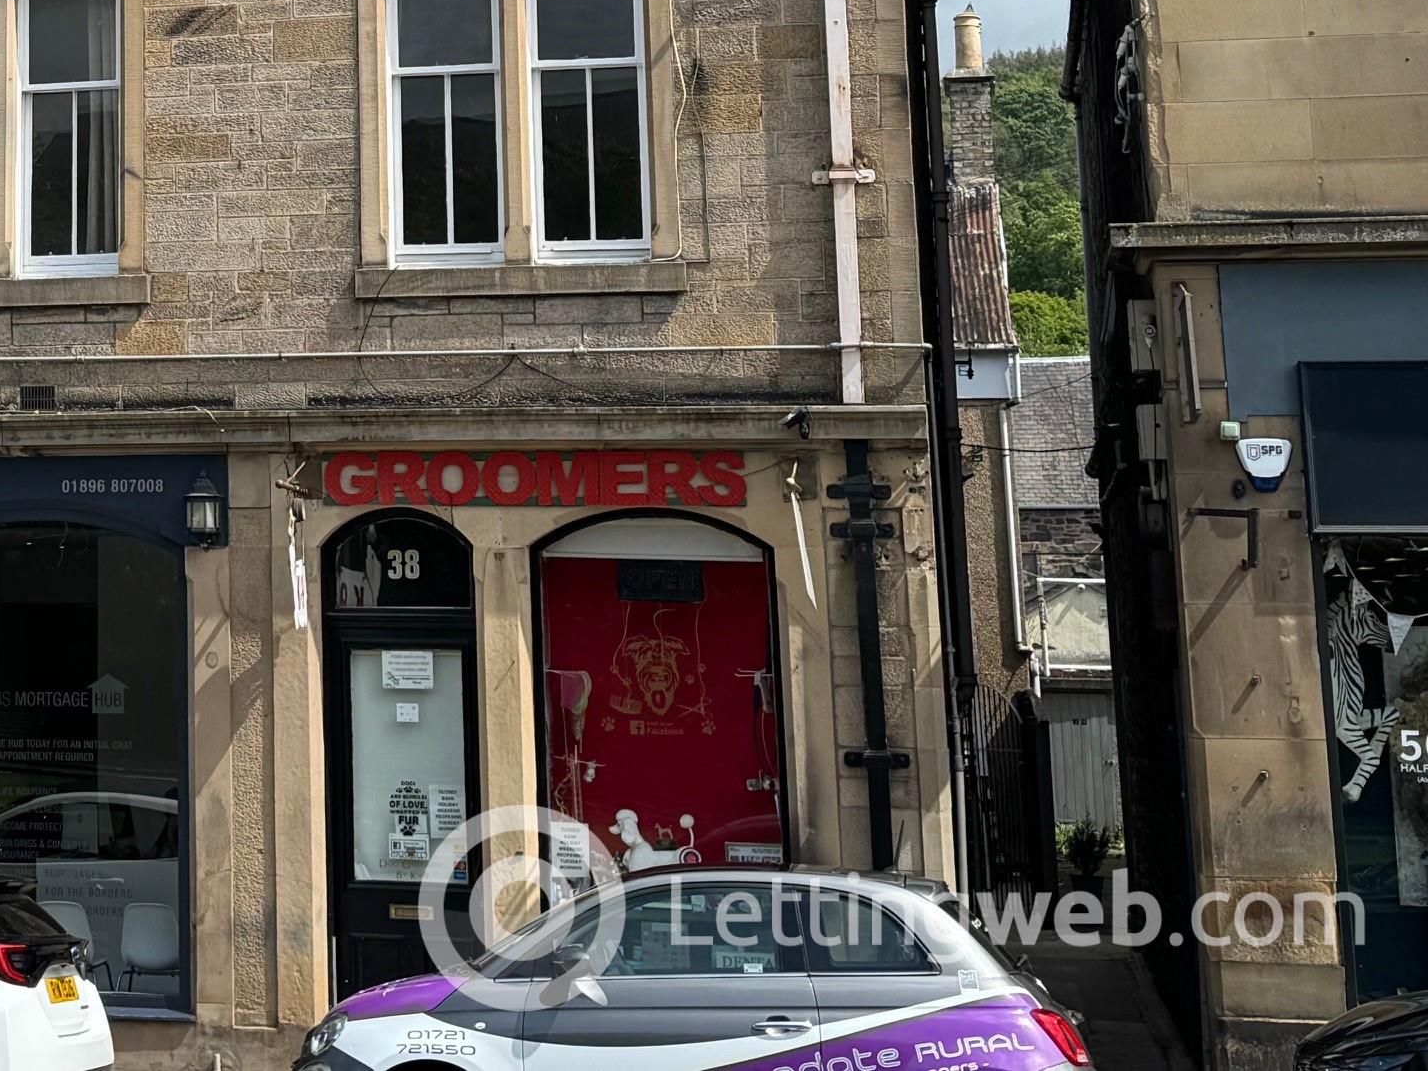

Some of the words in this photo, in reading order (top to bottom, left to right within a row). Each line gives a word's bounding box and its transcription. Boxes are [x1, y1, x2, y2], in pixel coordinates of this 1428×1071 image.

[1261, 445, 1283, 455] SPG
[323, 450, 748, 507] GROOMERS
[61, 479, 106, 493] 01896
[111, 478, 164, 493] 807008
[387, 549, 420, 580] 38
[15, 690, 89, 707] MORTGAGE
[94, 690, 123, 707] HUB
[26, 738, 51, 749] TODAY
[52, 739, 68, 749] FOR
[69, 739, 81, 749] AN
[111, 739, 133, 750] CHAT
[1400, 729, 1428, 761] 5
[54, 751, 95, 762] REQUIRED
[389, 800, 401, 808] OF
[402, 800, 428, 810] LOVE,
[398, 815, 419, 825] FUR
[44, 887, 64, 898] FOR
[88, 888, 133, 899] BORDERS
[407, 1030, 466, 1041] 01721
[396, 1043, 476, 1056] 721550
[914, 1032, 1037, 1064] RURAL
